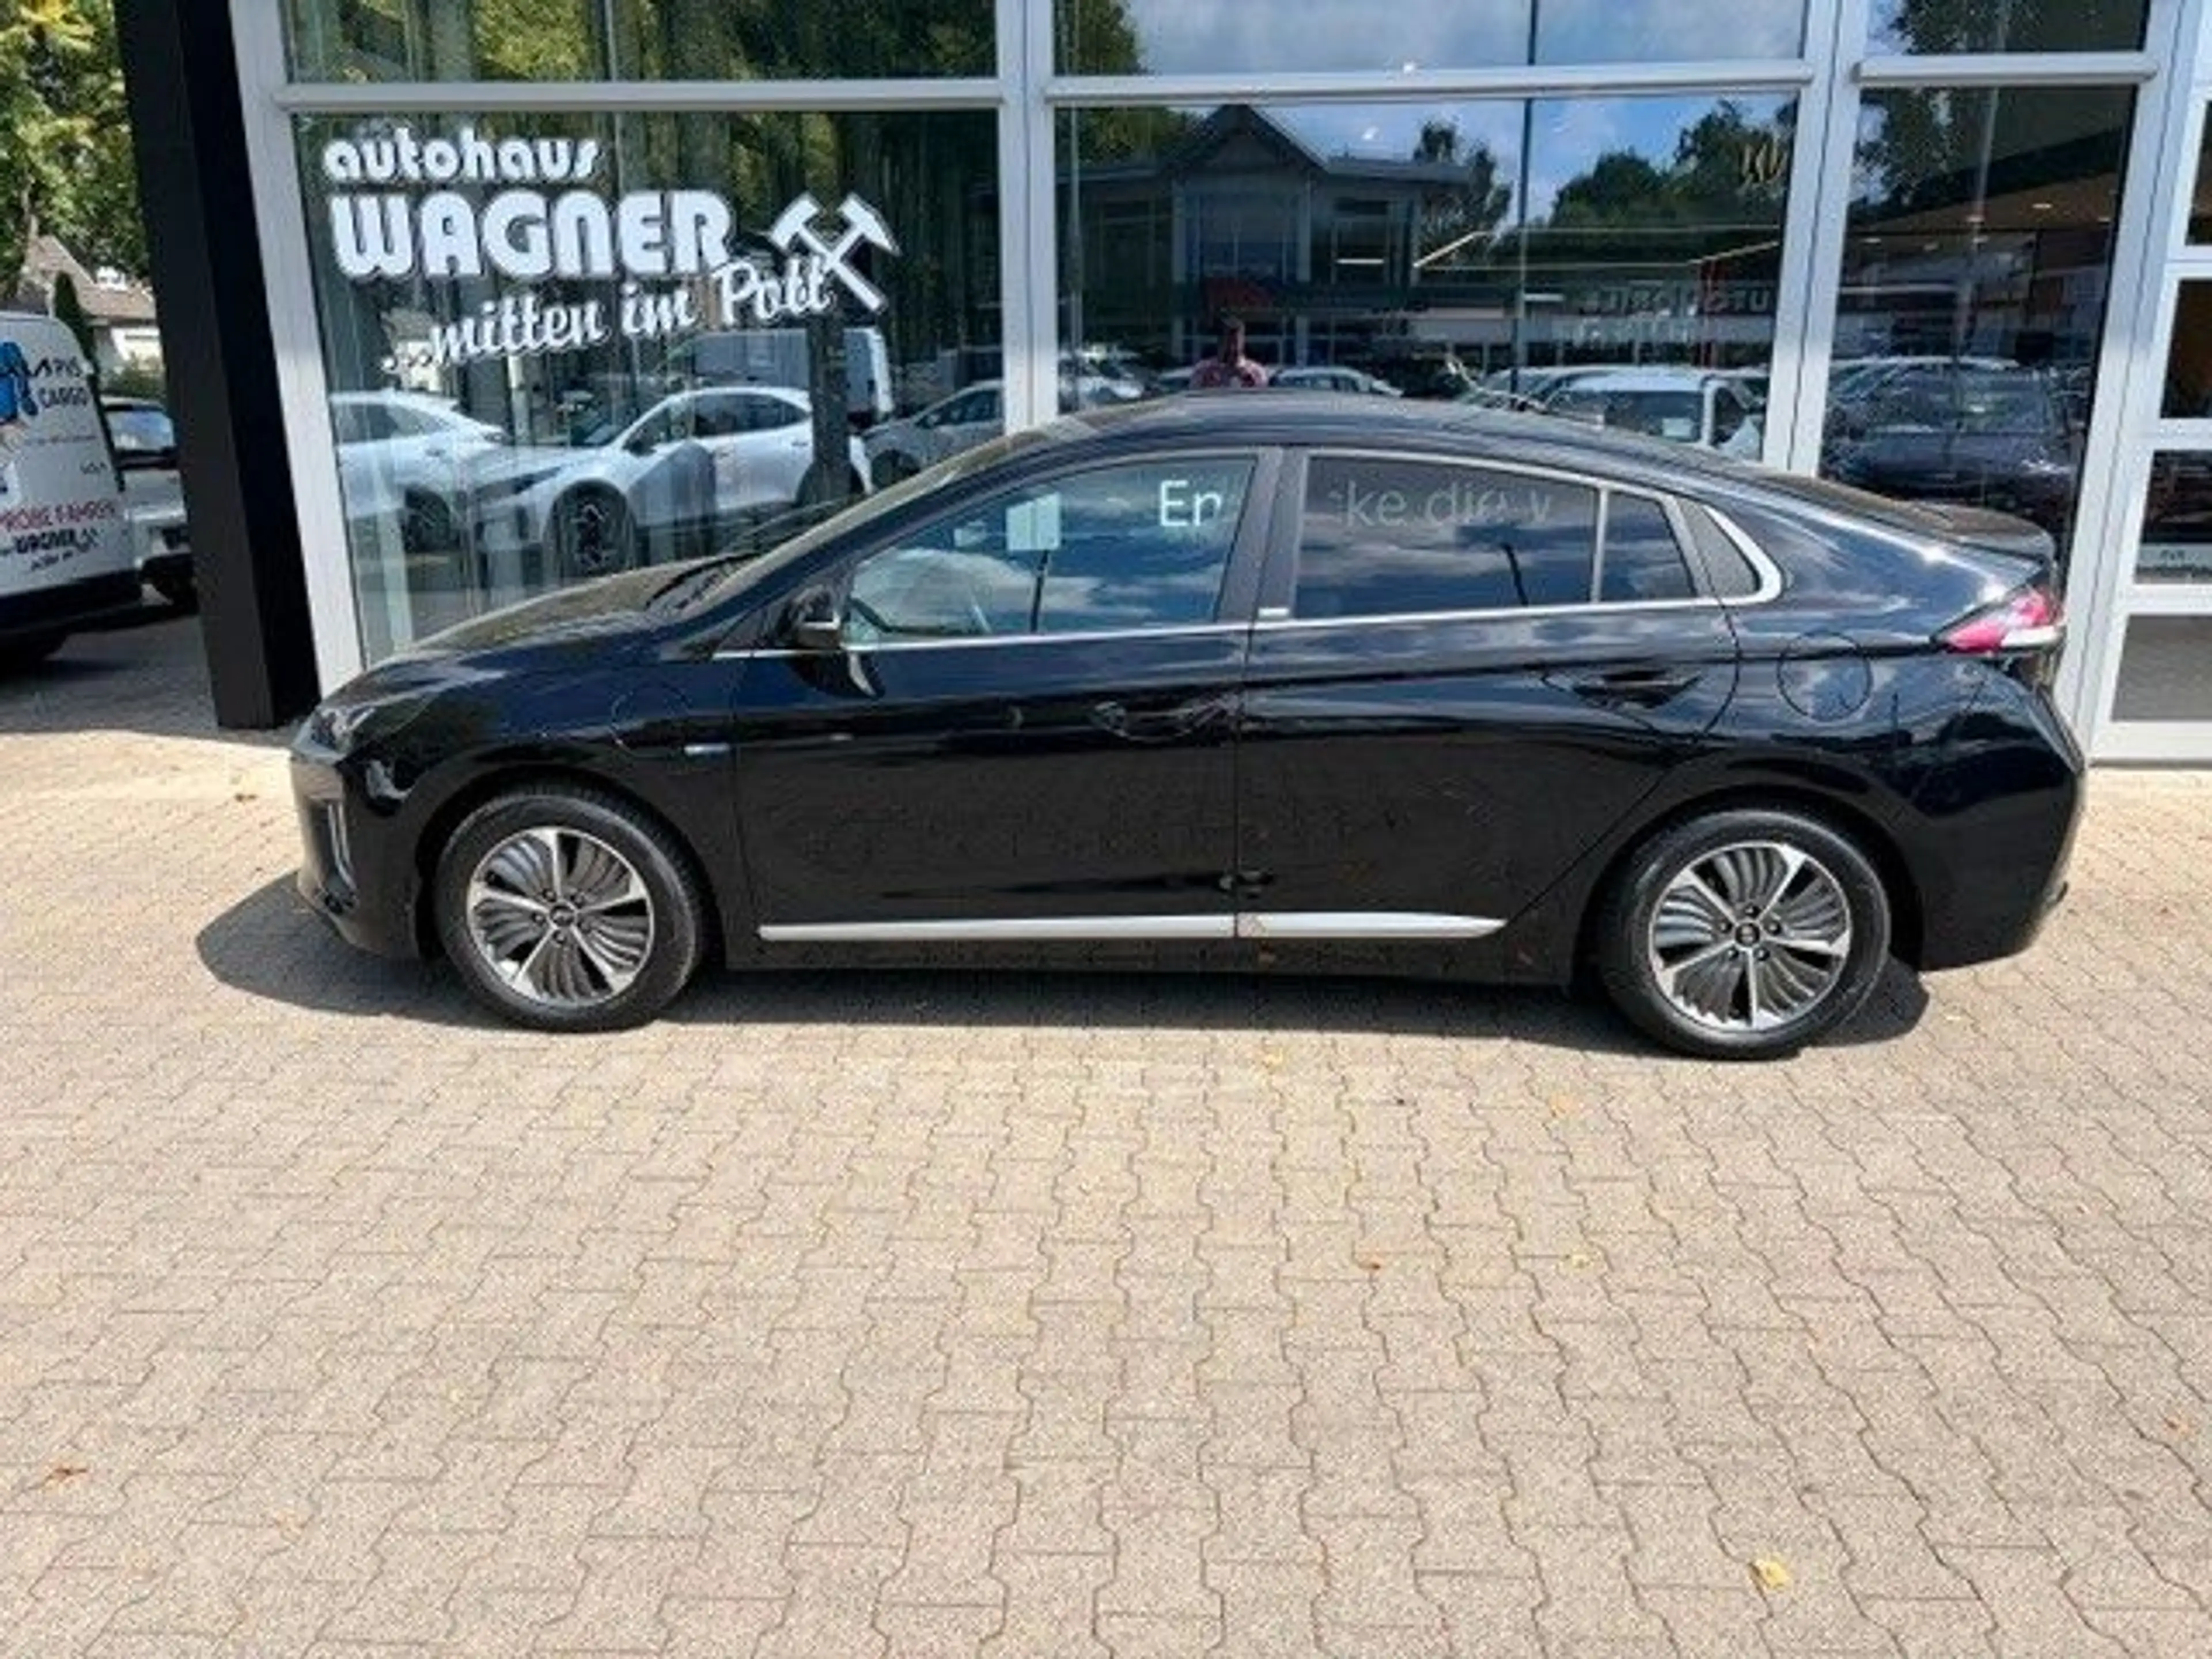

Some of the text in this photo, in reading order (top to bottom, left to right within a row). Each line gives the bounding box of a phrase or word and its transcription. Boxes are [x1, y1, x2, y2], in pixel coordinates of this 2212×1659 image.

[323, 127, 600, 183] autohaus
[329, 190, 730, 278] WAGNER
[622, 283, 696, 336] im
[713, 255, 835, 326] Pott
